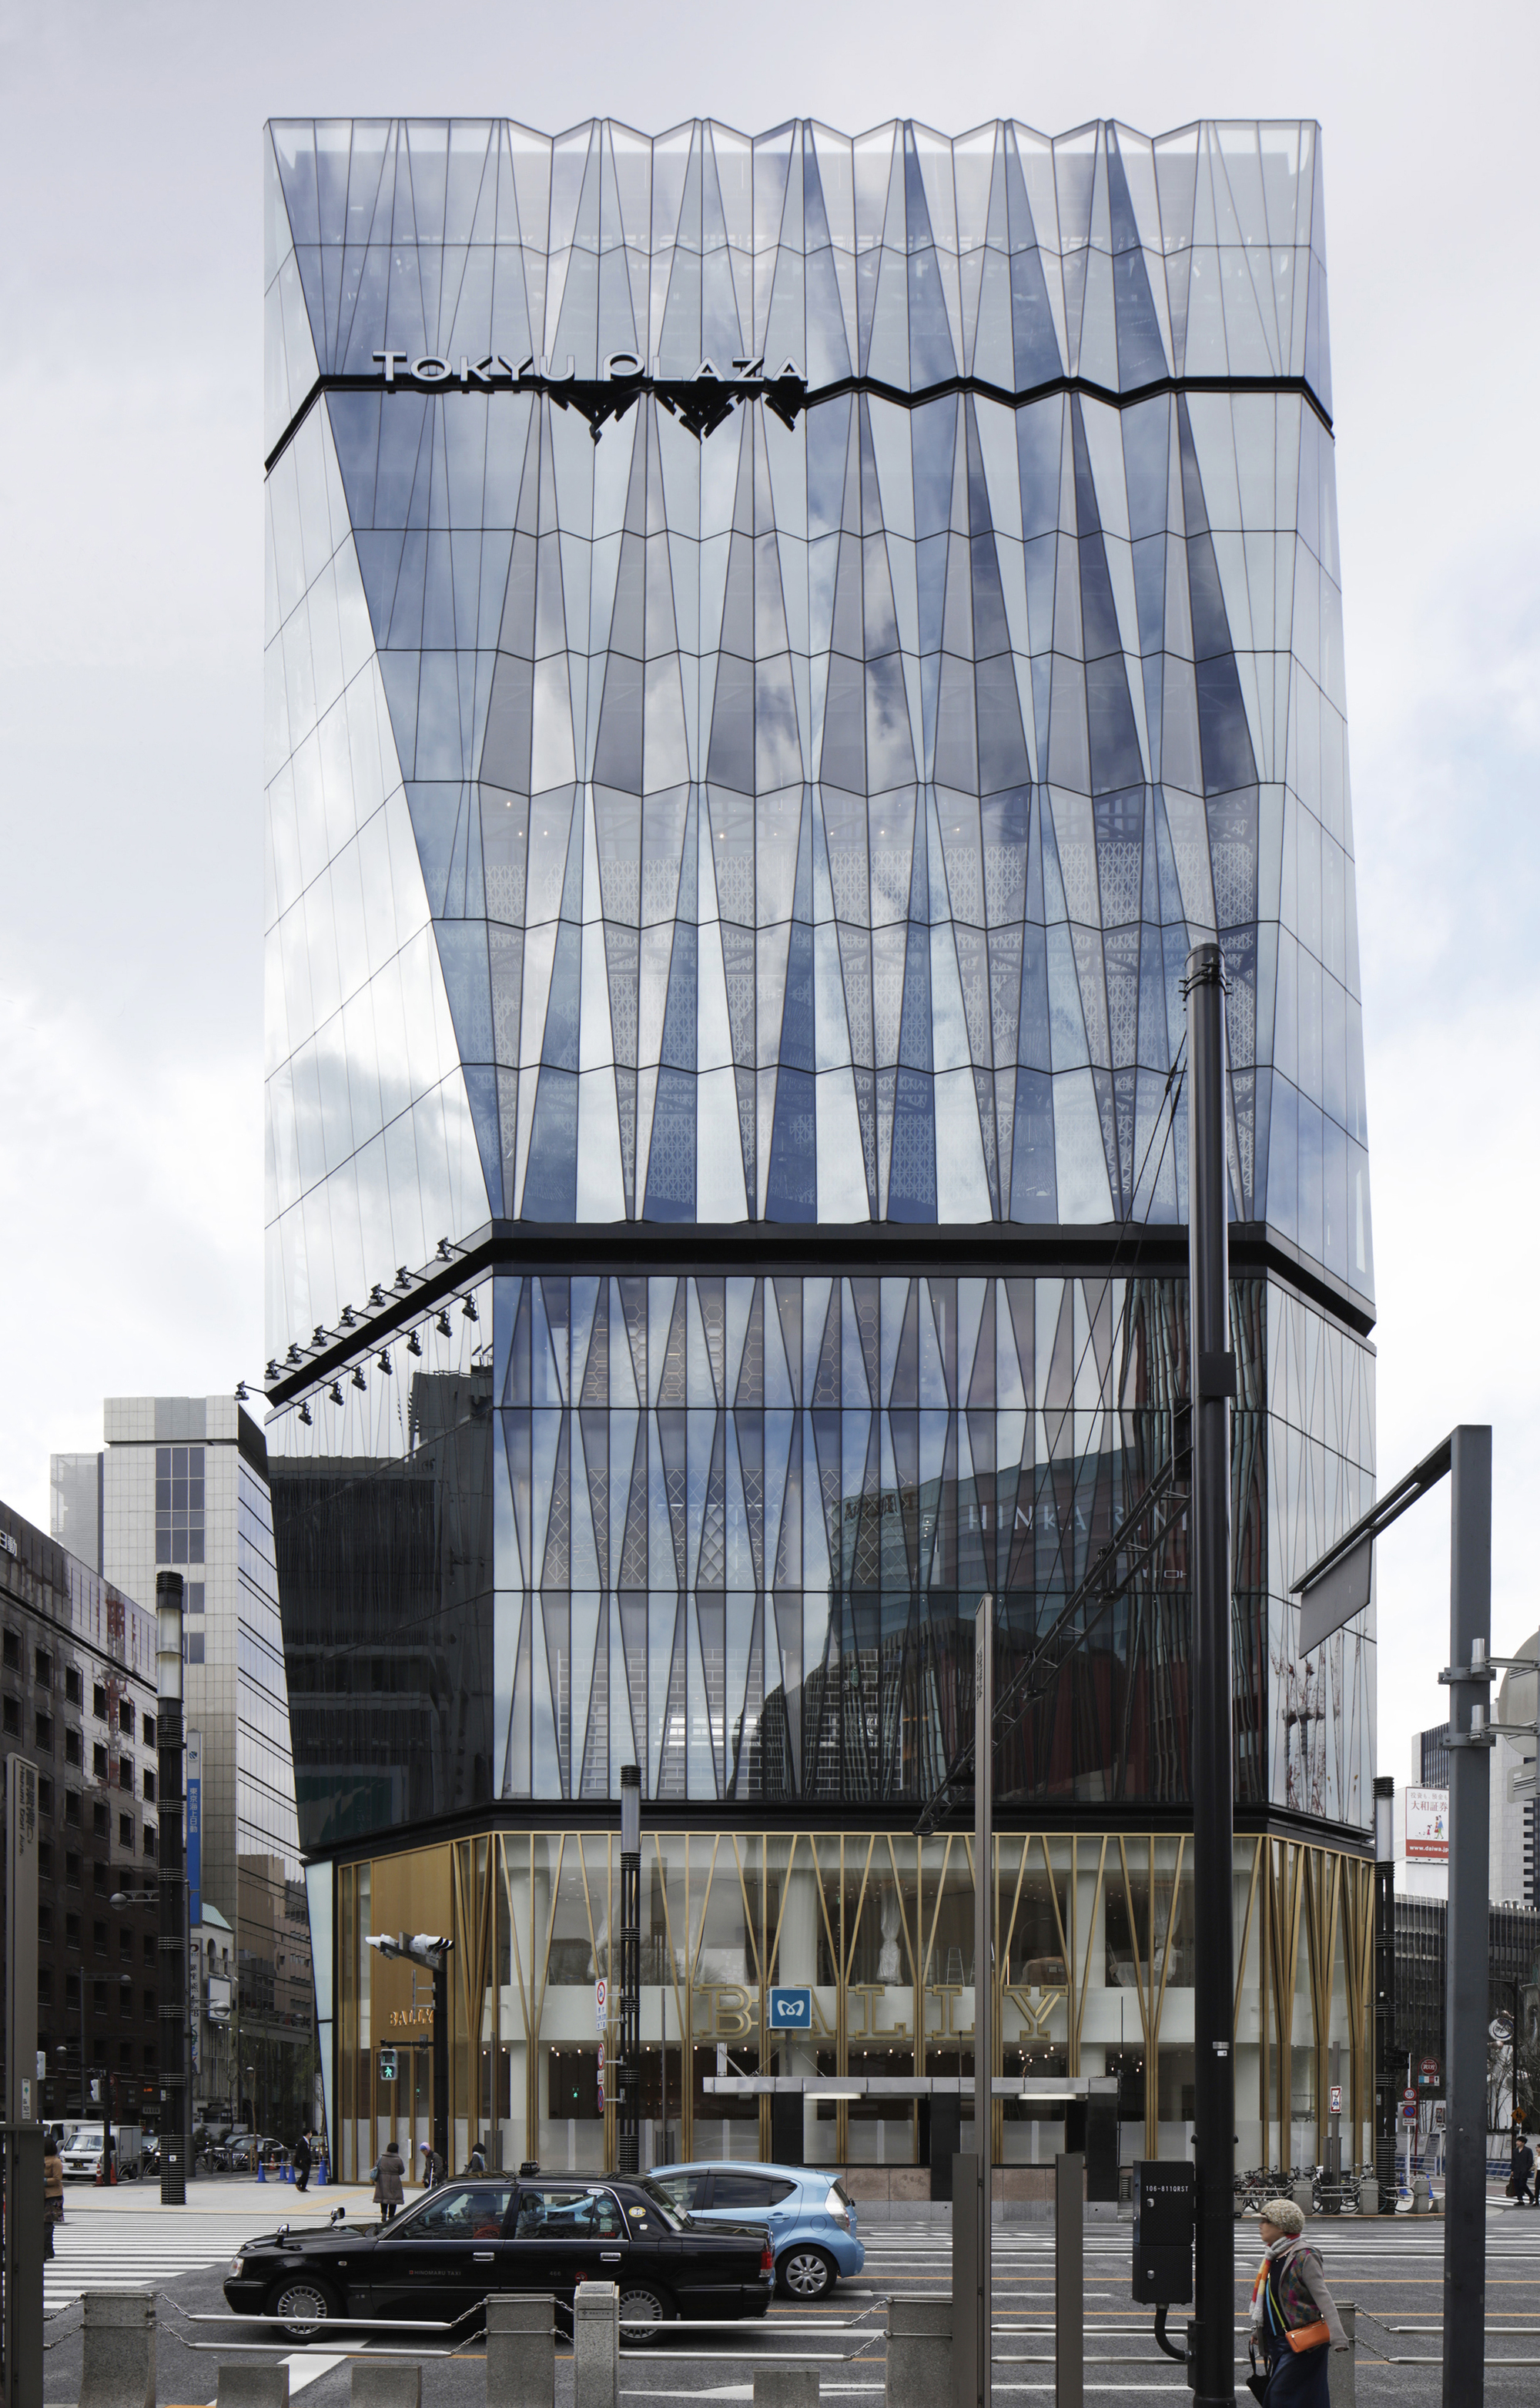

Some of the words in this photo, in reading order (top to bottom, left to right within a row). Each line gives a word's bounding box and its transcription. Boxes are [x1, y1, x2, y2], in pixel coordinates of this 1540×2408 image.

[373, 350, 575, 382] TOKYU
[603, 350, 808, 382] PLAZA
[189, 1787, 198, 1834] 東京海上日動
[1411, 1800, 1448, 1812] 大和証券
